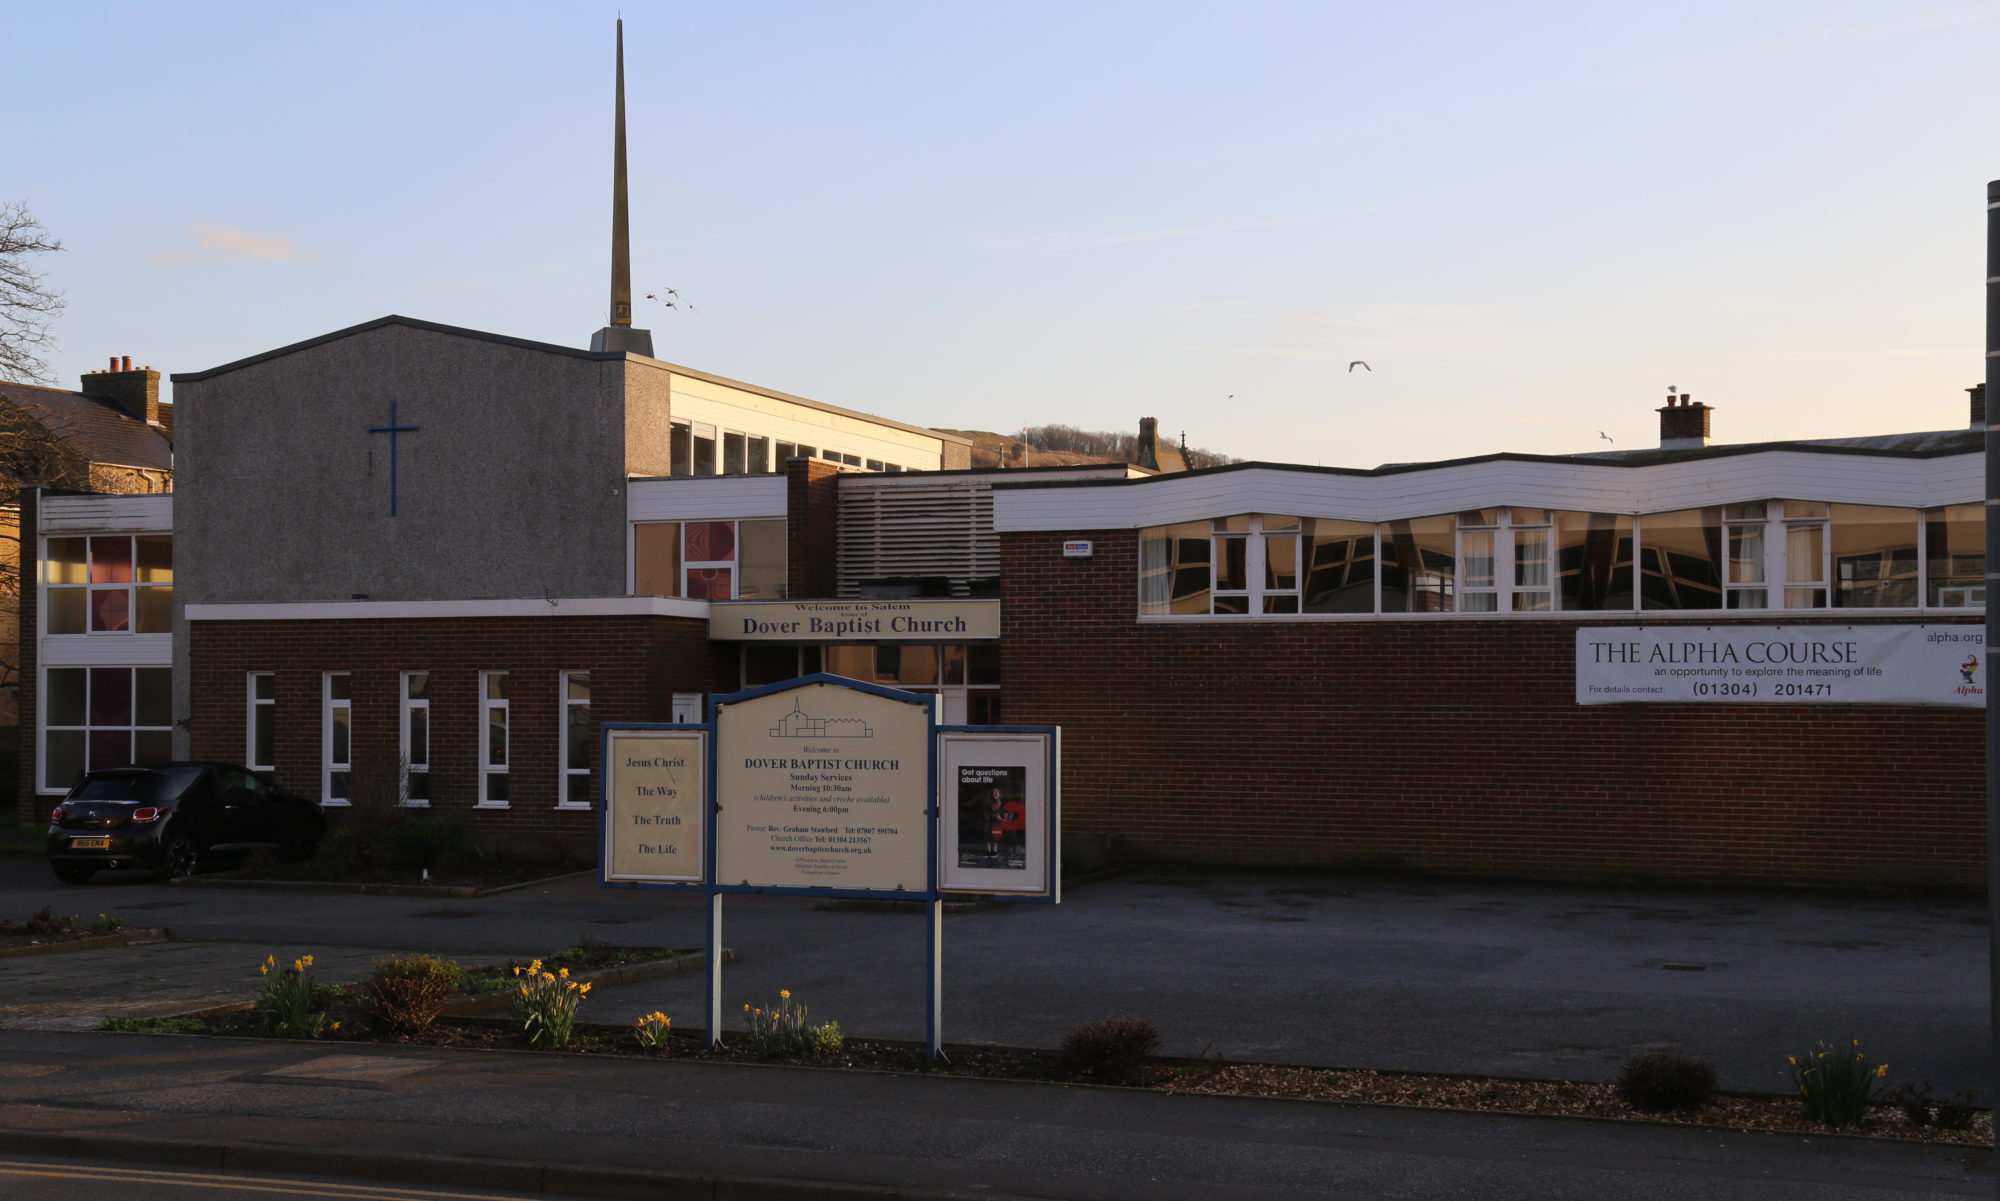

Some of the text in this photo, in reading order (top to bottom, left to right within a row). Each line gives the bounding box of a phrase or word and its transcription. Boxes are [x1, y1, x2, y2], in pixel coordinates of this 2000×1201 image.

[795, 603, 911, 611] Welcome to Salem
[743, 616, 967, 637] Dover Baptist Church
[1927, 632, 1983, 644] alpha.org
[1589, 641, 1858, 664] THE ALPHA COURSE
[1654, 667, 1882, 679] an opportunity to explore the meaning of life
[1589, 683, 1832, 697] For details contact: (01304) 201471
[1953, 686, 1983, 696] Alpha
[803, 746, 840, 754] Welcome to
[626, 757, 685, 767] Jesus Christ
[745, 758, 899, 770] DOVER BAPTIST CHURCH
[790, 773, 853, 782] Sunday Services
[961, 768, 1008, 777] Got questions
[961, 776, 993, 784] about life
[635, 786, 678, 799] The Way
[790, 784, 852, 793] Morning 10:30am
[788, 795, 817, 803] activities
[818, 795, 832, 803] and
[856, 795, 891, 804] available)
[793, 805, 849, 815] Evening 6:00pm
[632, 815, 681, 825] The Truth
[810, 826, 838, 834] Stanford
[794, 835, 813, 843] Office
[637, 844, 677, 854] The Life
[770, 845, 872, 855] www.doverbaptistchurch.org.uk
